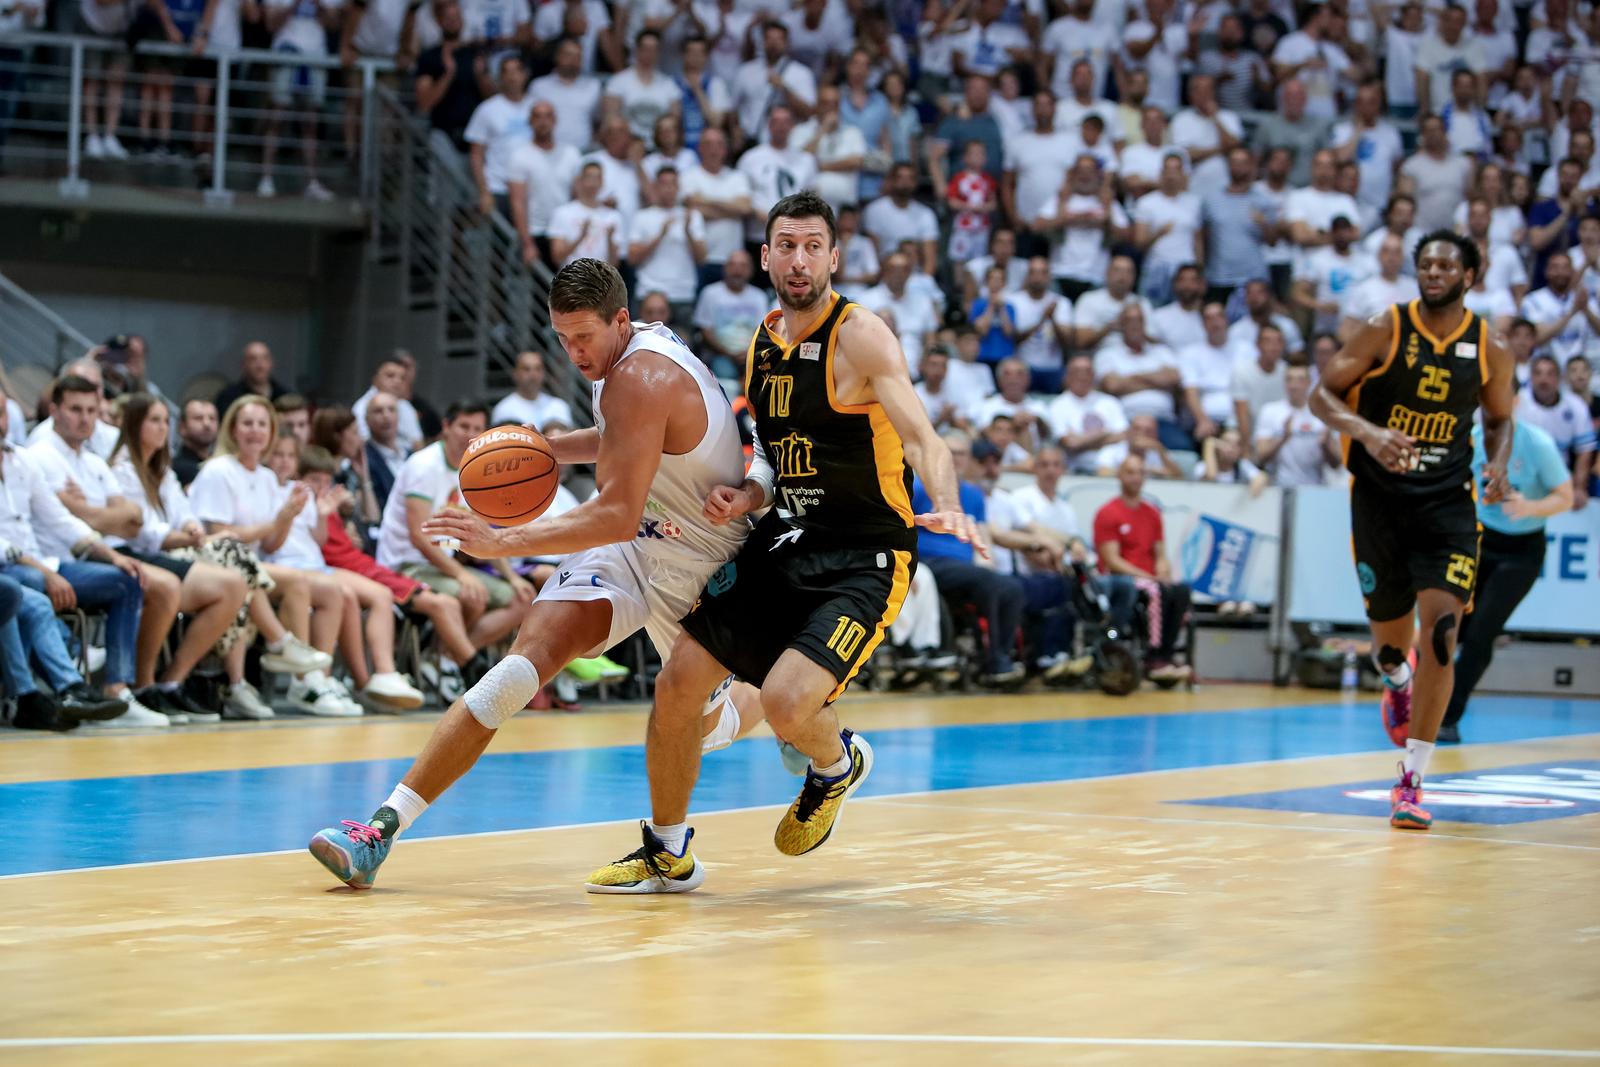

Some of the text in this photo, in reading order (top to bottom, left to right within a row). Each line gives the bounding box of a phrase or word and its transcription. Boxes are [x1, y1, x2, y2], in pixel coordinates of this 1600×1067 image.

[769, 375, 794, 417] 10
[1416, 364, 1452, 402] 25
[468, 431, 533, 454] Wilson
[483, 458, 521, 476] EVO
[1445, 553, 1475, 591] 25
[826, 616, 866, 662] 10
